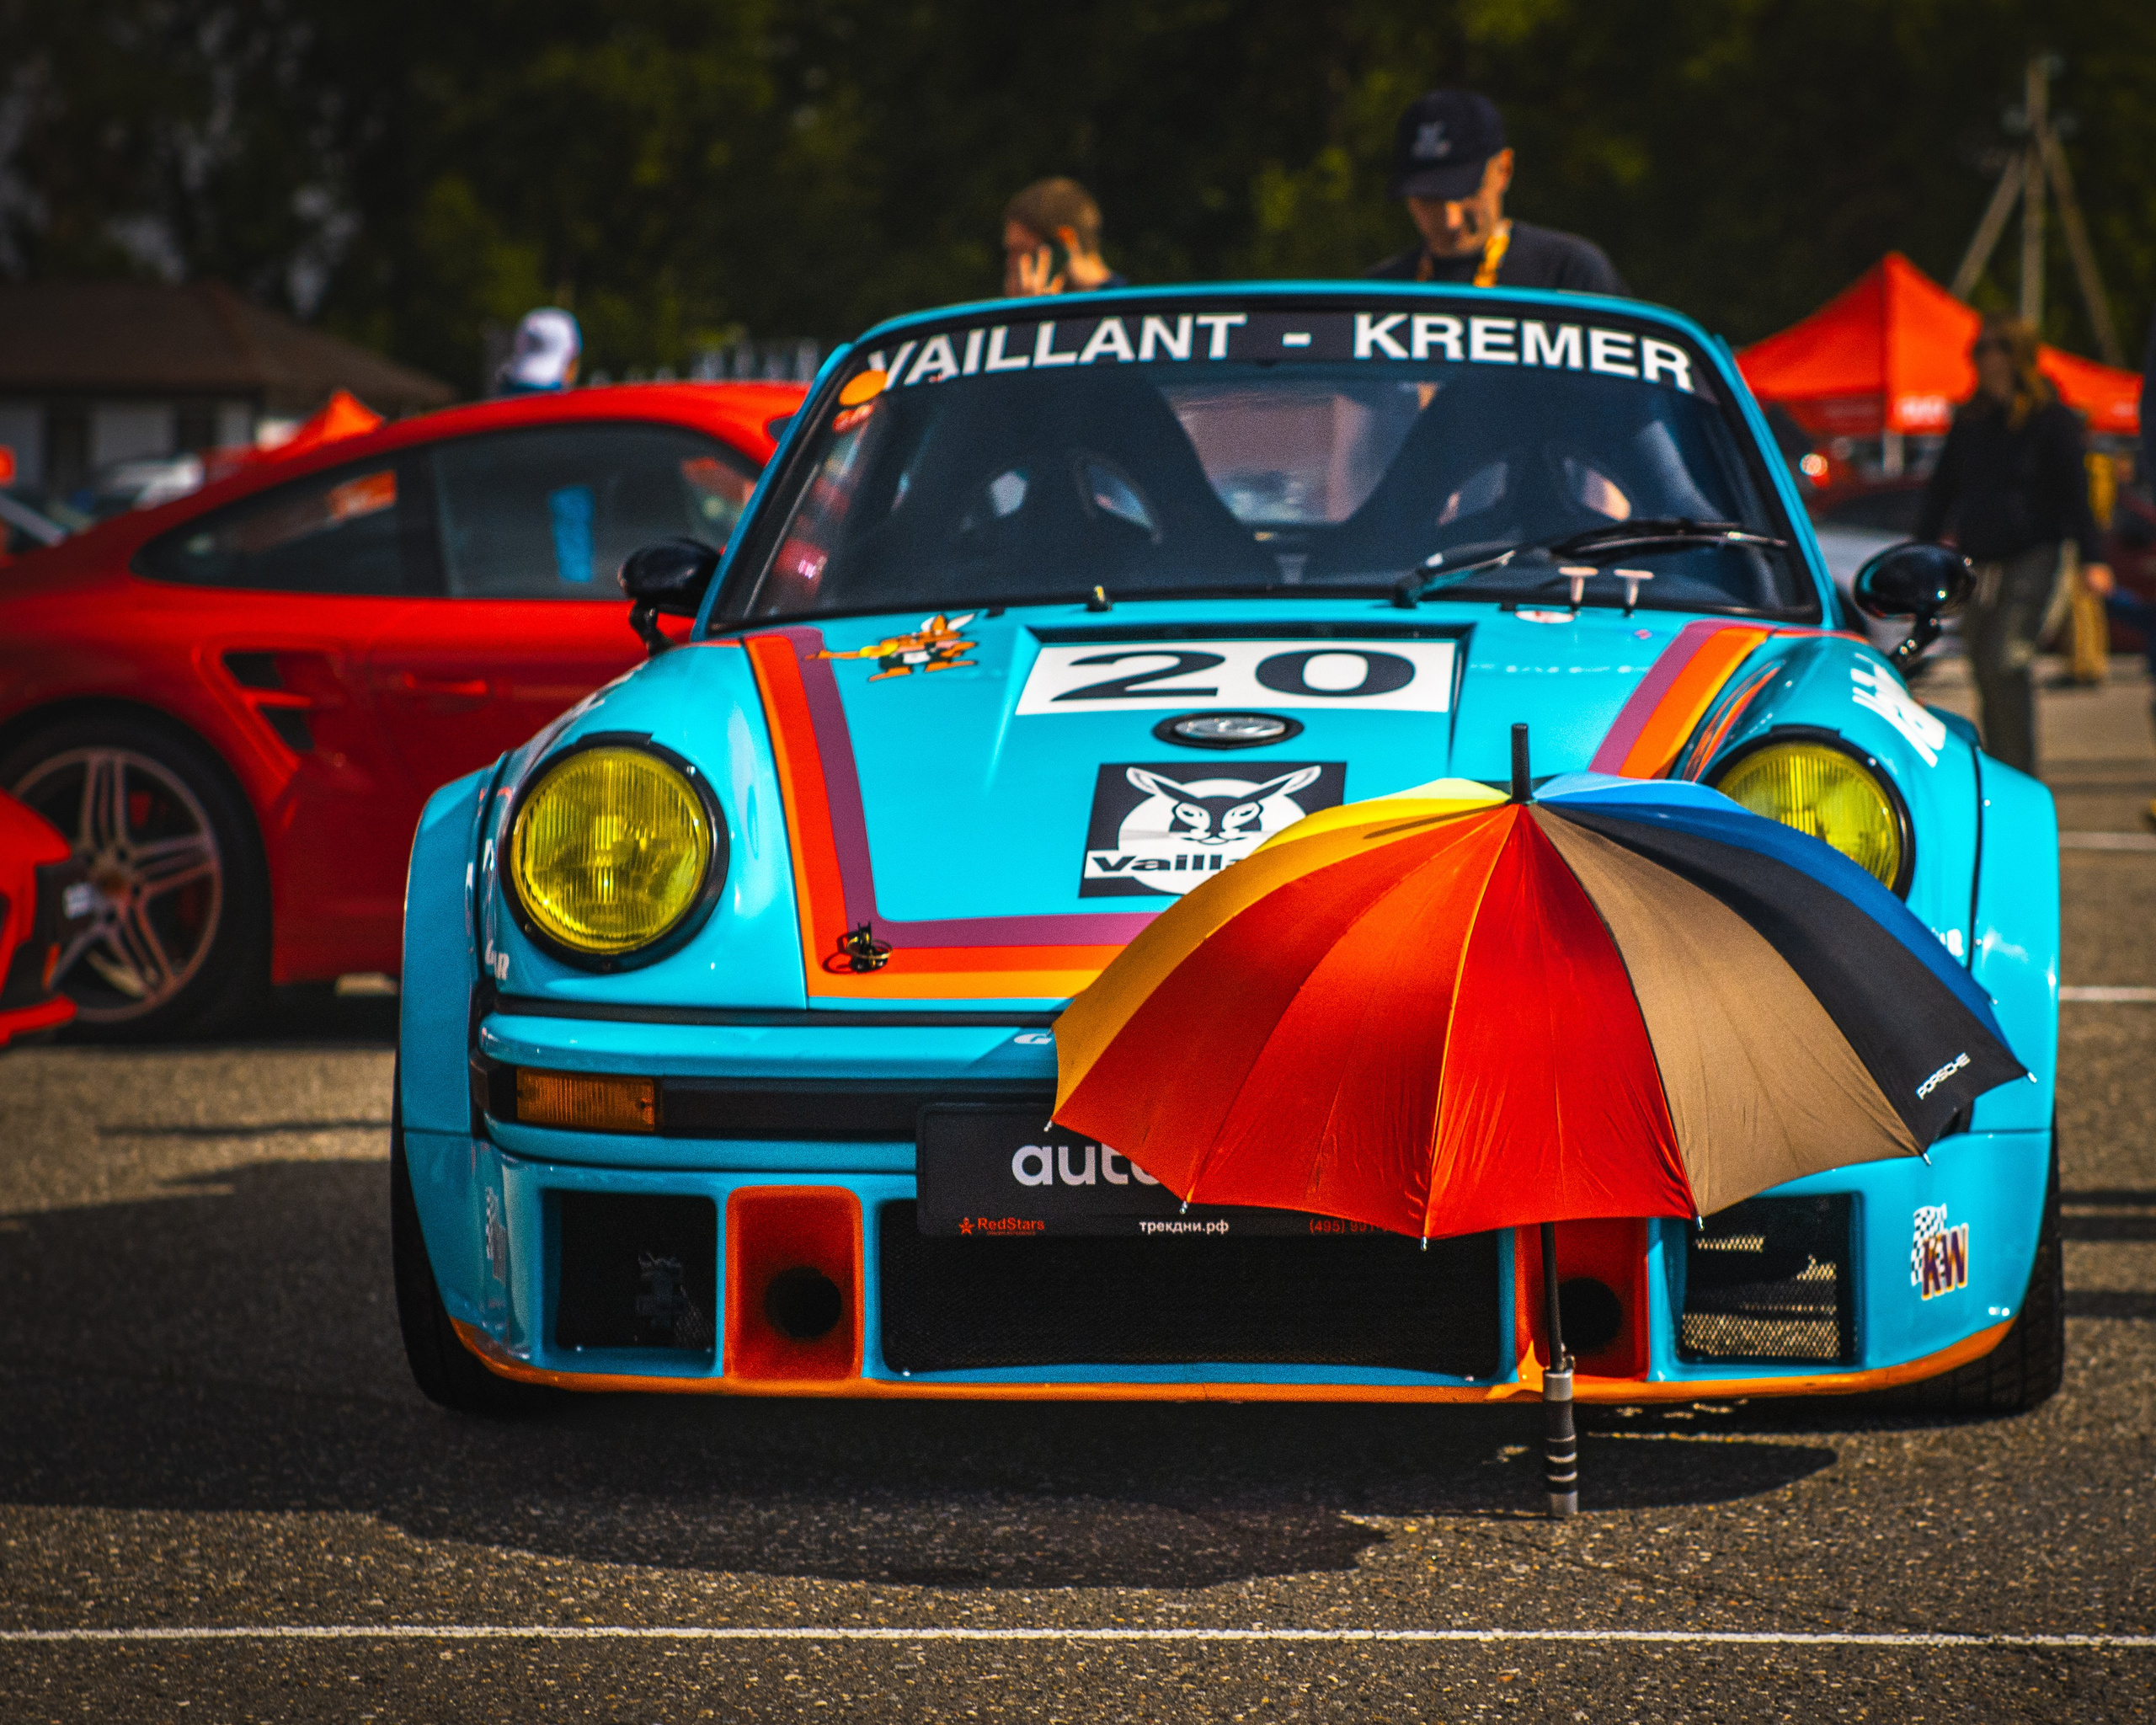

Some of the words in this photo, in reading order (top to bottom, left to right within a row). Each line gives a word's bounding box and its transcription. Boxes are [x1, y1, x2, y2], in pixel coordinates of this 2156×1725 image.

[868, 313, 1247, 390] VAILLANT
[1353, 312, 1694, 393] KREMER
[1050, 648, 1417, 702] 20
[1092, 854, 1243, 873] Vaill
[1916, 1052, 1971, 1100] PORSCHE
[977, 1217, 1045, 1231] RedStars
[1139, 1219, 1230, 1235] трекдни.рф
[1309, 1218, 1345, 1234] (495)
